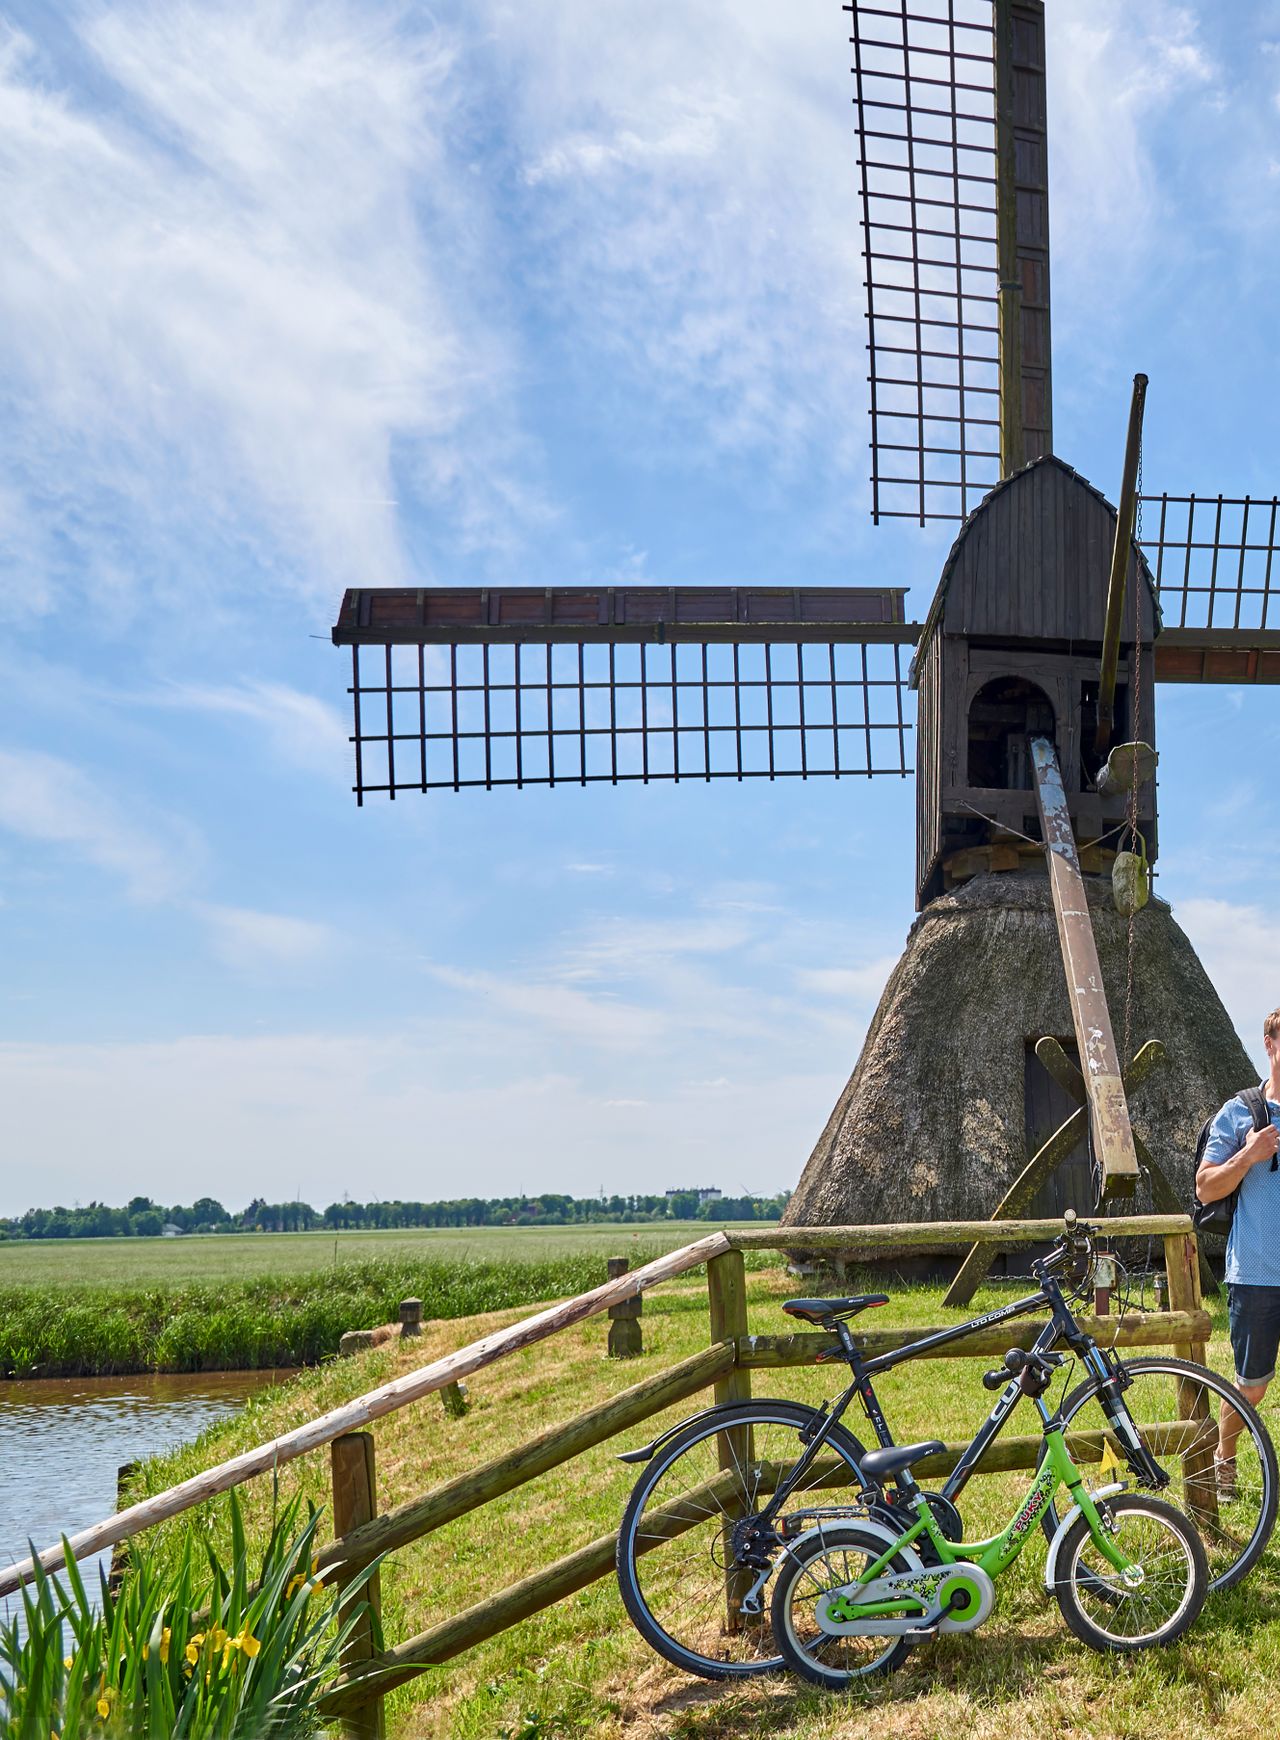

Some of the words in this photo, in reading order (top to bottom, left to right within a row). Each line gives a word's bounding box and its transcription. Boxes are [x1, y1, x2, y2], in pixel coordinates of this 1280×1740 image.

[971, 1318, 988, 1329] LTD
[988, 1306, 1016, 1322] COMP
[1014, 1490, 1043, 1532] PUKY
